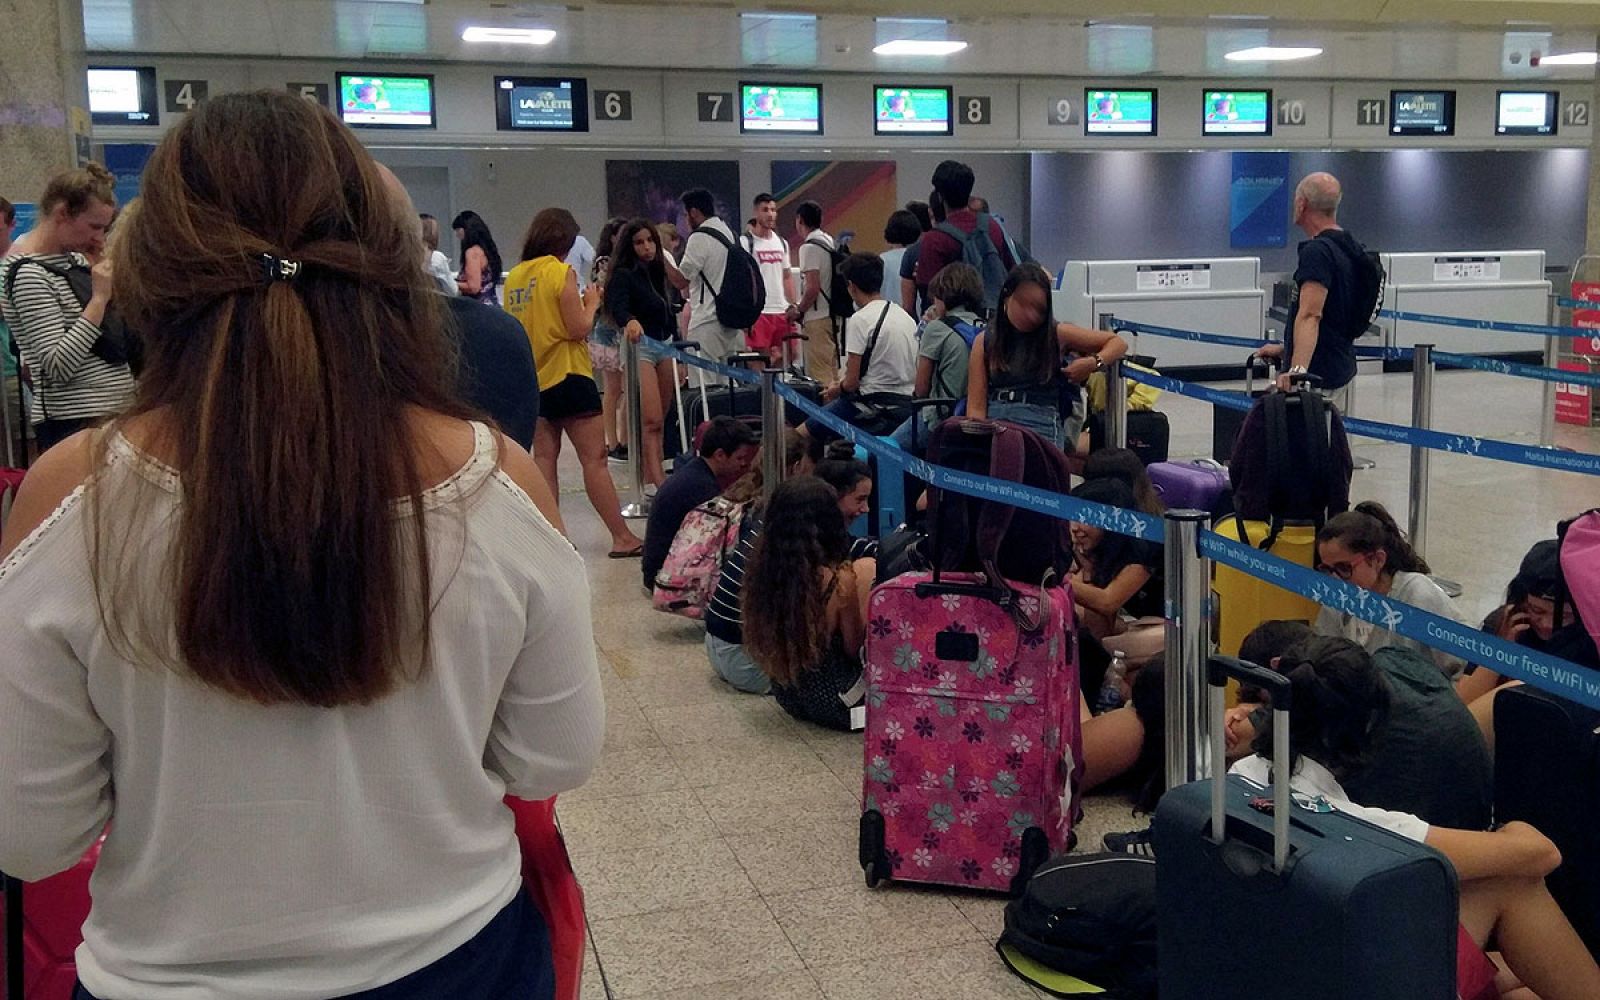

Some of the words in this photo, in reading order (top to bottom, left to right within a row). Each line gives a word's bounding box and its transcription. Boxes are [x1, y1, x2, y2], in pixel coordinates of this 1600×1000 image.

[175, 83, 195, 111] 4
[301, 86, 318, 104] 5
[604, 92, 621, 118] 6
[707, 95, 723, 120] 7
[967, 100, 982, 122] 8
[1056, 99, 1071, 122] 9
[1280, 102, 1303, 124] 10
[1363, 102, 1381, 124] 11
[1566, 103, 1586, 125] 12
[1249, 557, 1265, 571] you
[1427, 621, 1477, 652] Connect
[1479, 641, 1493, 658] to
[1495, 650, 1519, 667] our
[1522, 654, 1549, 679] free
